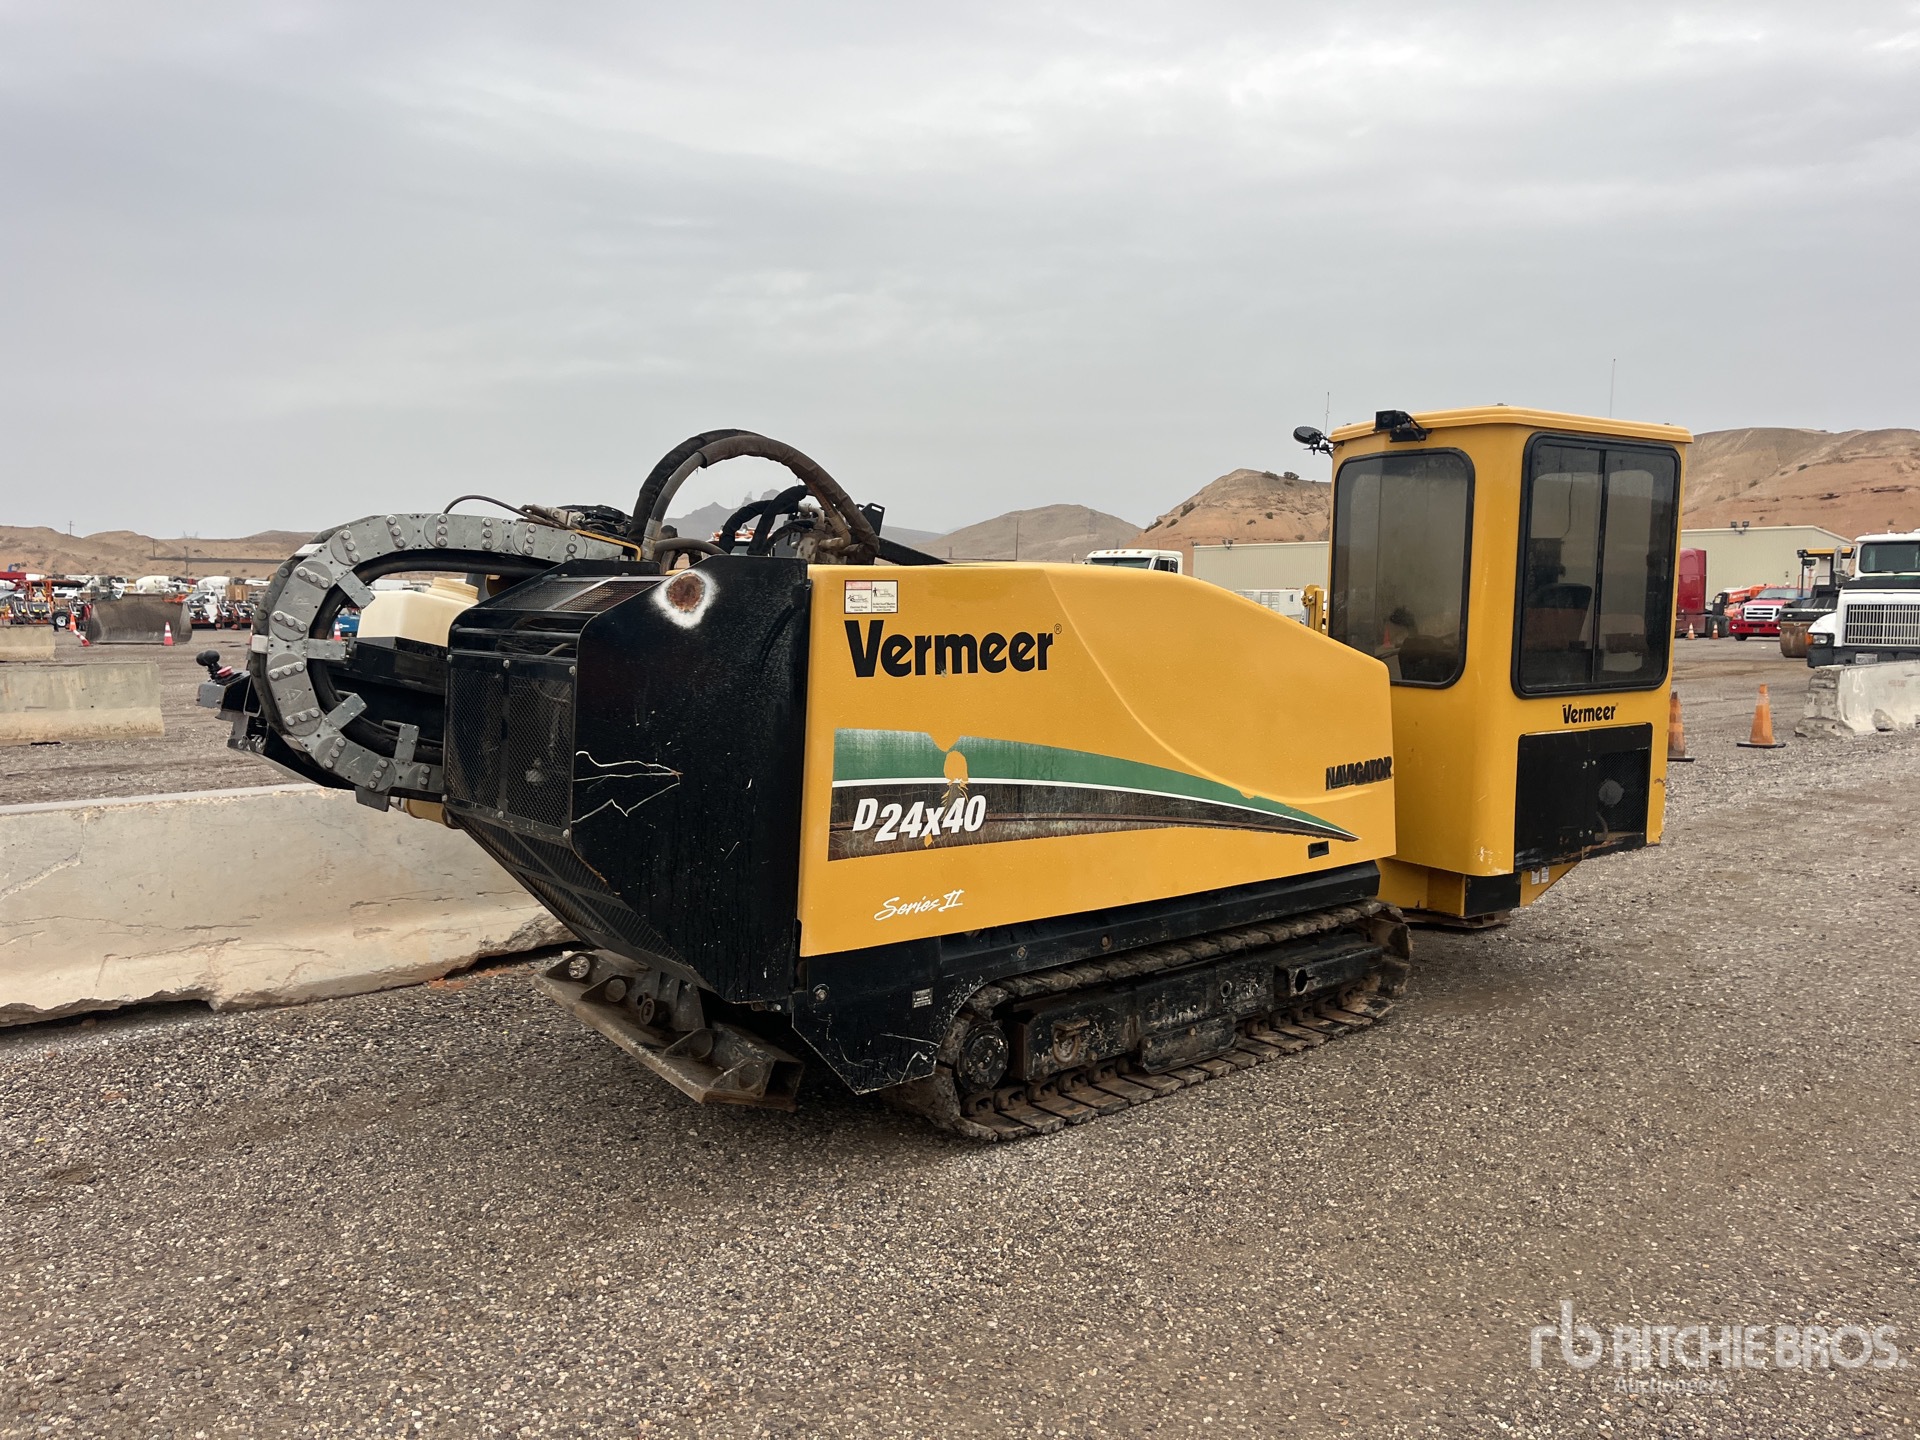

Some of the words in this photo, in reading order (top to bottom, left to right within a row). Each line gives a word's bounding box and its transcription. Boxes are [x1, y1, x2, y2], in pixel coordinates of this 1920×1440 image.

[844, 619, 1054, 678] Vermeer
[1562, 703, 1616, 724] Vermeer
[1325, 755, 1393, 792] NAVIGATOR
[852, 795, 987, 843] D24x40
[873, 895, 941, 921] Series
[938, 889, 965, 912] II
